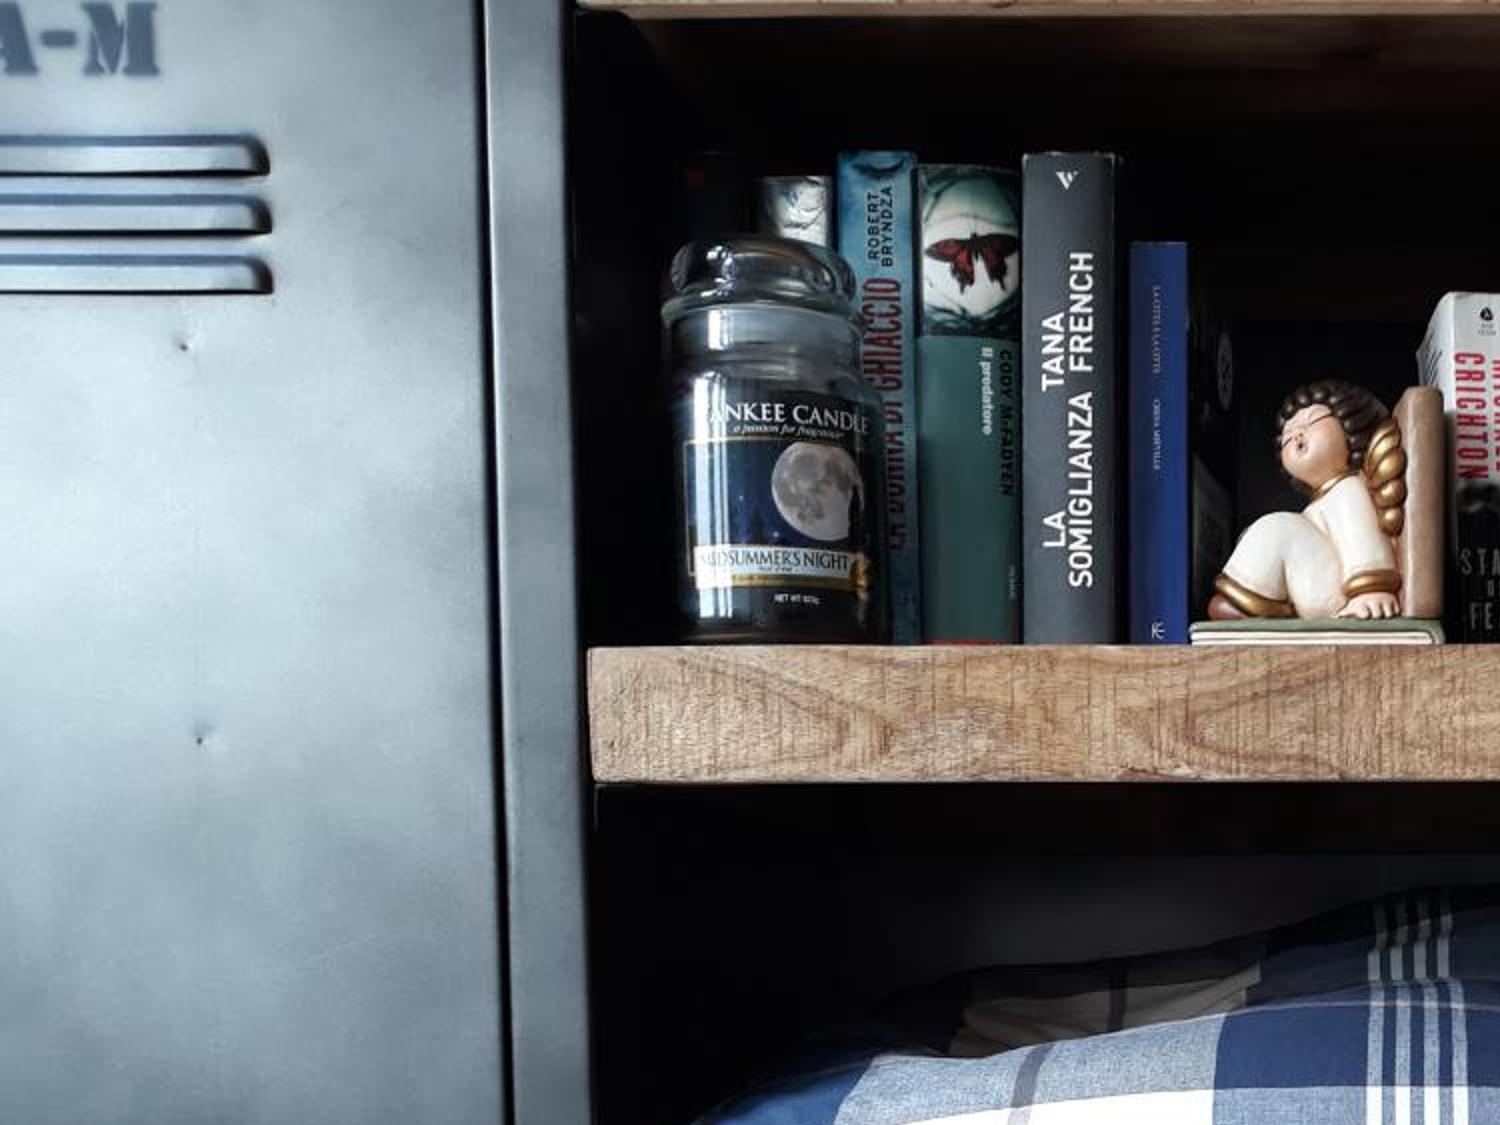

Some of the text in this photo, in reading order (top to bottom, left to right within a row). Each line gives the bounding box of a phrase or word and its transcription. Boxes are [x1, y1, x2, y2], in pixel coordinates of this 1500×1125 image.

[867, 191, 880, 260] ROBERT
[880, 186, 893, 267] BRYNDZA
[863, 278, 902, 391] GHIACCIO
[1042, 311, 1065, 393] TANA
[1068, 252, 1093, 372] FRENCH
[793, 404, 870, 434] CANDLE
[979, 347, 994, 436] Il predatore
[1454, 352, 1490, 480] CRICHTON
[1043, 510, 1067, 547] LA
[1068, 391, 1093, 588] SOMIGLIANZA
[804, 552, 849, 572] NIGHT
